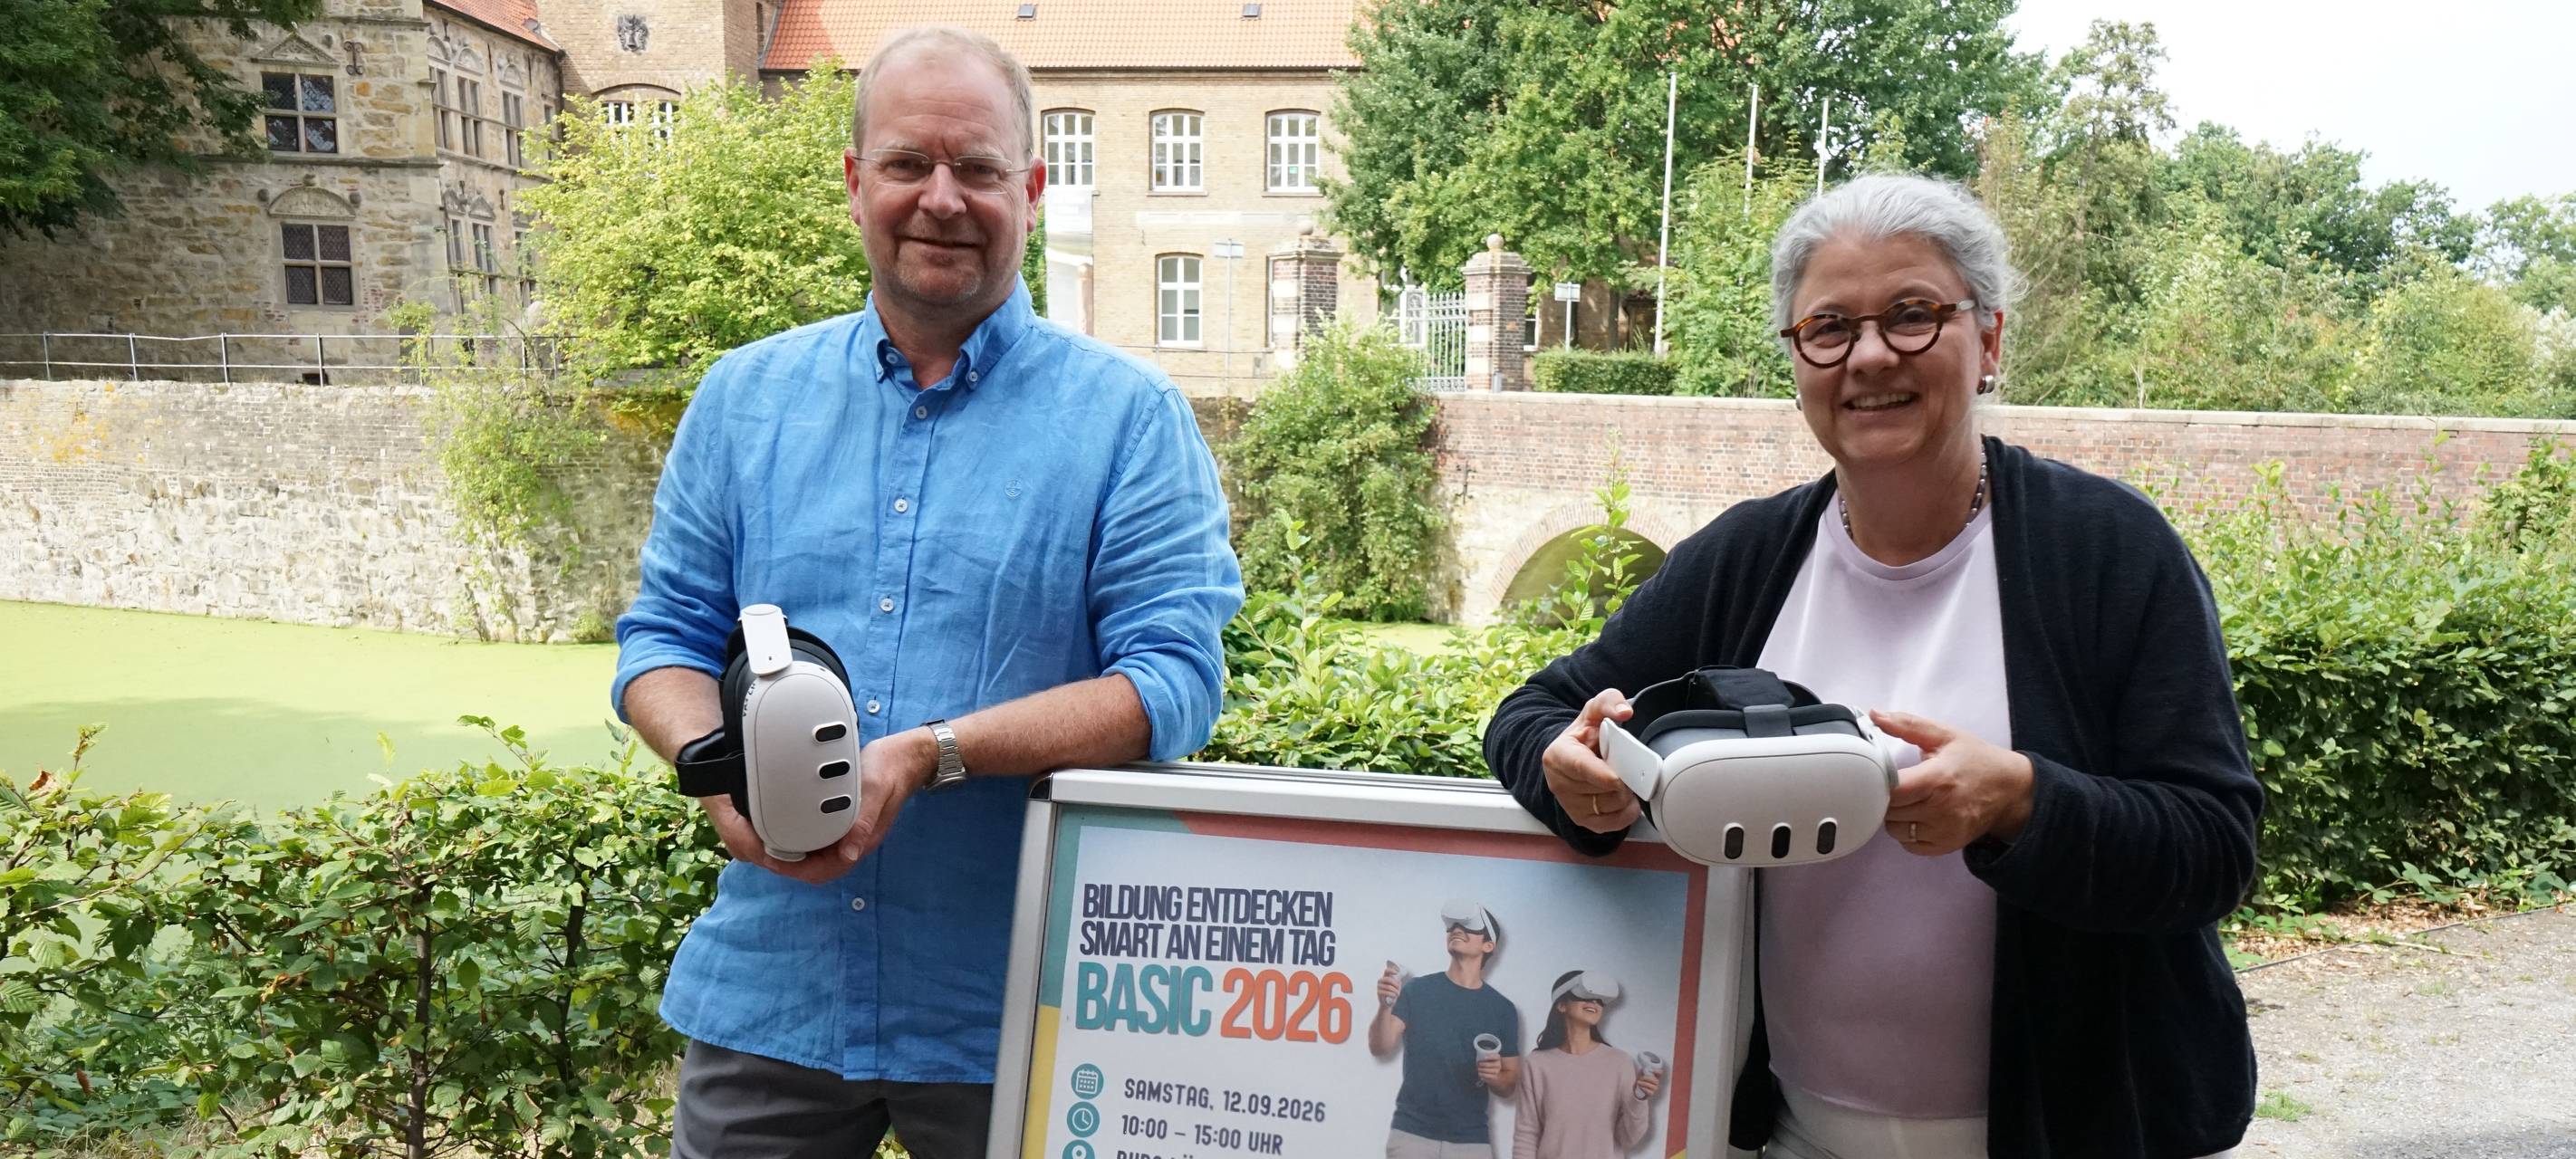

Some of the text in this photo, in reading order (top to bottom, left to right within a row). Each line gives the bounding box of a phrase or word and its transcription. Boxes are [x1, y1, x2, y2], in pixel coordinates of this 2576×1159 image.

[1082, 884, 1333, 928] BILDUNG ENTDECKEN
[1080, 921, 1337, 966] SMART AN EINEM TAG
[1075, 962, 1354, 1045] BASIC 2026
[1124, 1078, 1326, 1123] SAMSTAG, 12.09.2026
[1121, 1115, 1168, 1140] 10:00
[1194, 1124, 1242, 1150] 15:00
[1247, 1131, 1283, 1155] UHR
